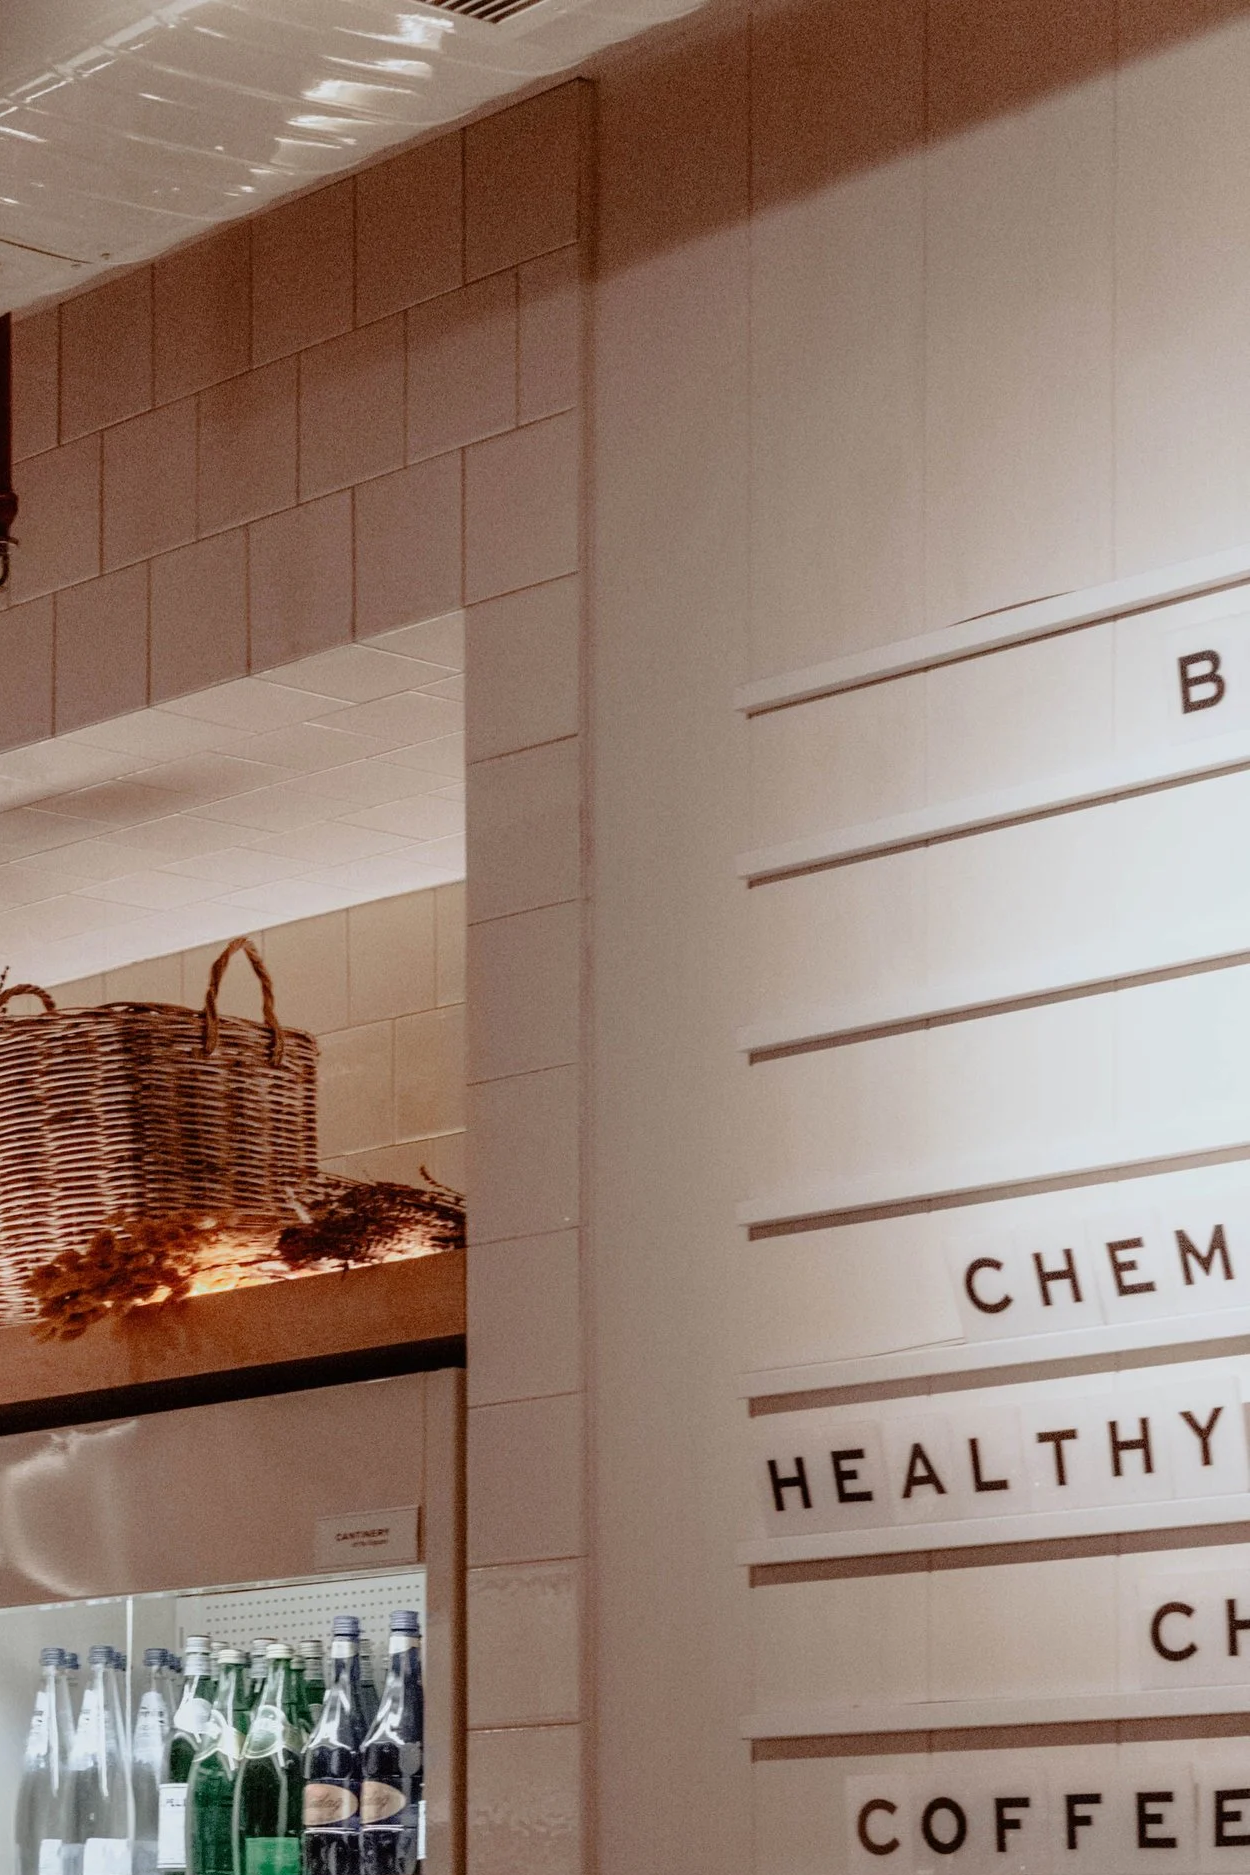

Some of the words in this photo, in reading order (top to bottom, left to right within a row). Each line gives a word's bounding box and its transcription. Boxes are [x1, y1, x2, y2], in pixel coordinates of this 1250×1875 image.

[1177, 649, 1226, 715] B
[963, 1224, 1235, 1314] CHEM
[767, 1406, 1224, 1511] HEALTHY
[1151, 1599, 1250, 1662] CH
[857, 1788, 1250, 1856] COFFEE
